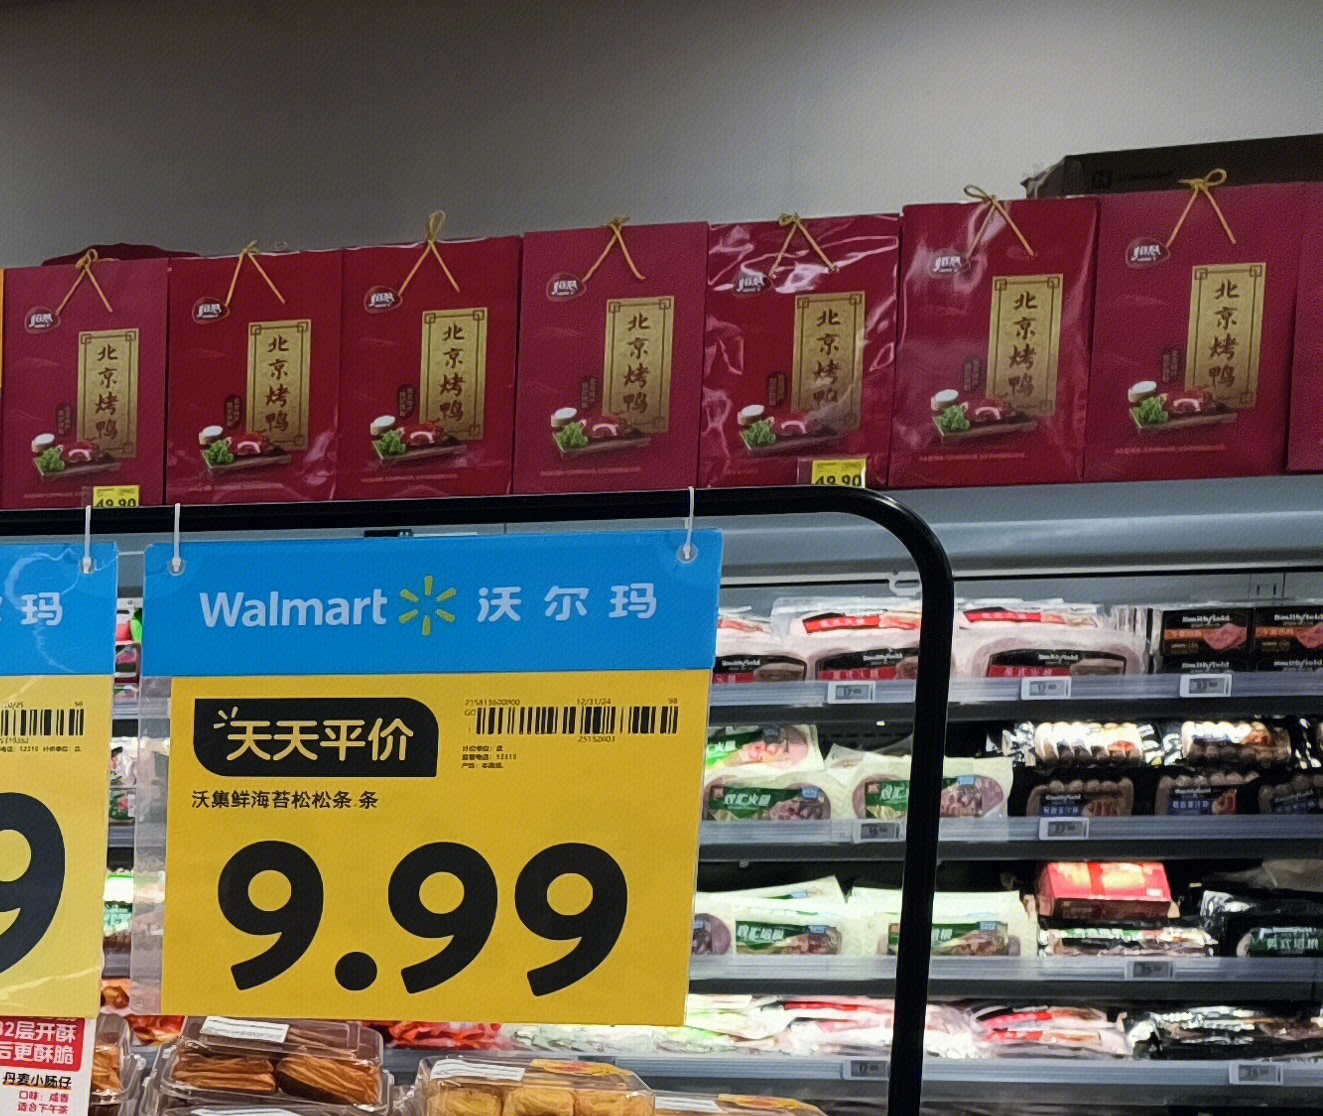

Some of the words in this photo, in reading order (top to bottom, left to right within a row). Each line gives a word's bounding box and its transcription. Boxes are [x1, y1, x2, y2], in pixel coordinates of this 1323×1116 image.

[264, 335, 290, 432] 北京烤鸭
[439, 324, 466, 422] 北京烤鸭
[622, 312, 651, 414] 北京烤鸭
[1007, 291, 1038, 397] 北京烤鸭
[1208, 280, 1240, 390] 北京烤鸭
[95, 343, 119, 441] 北京烤鸭
[95, 498, 136, 507] 4990
[815, 474, 861, 484] 4990
[200, 589, 387, 627] Walmart
[477, 583, 657, 622] 沃尔玛
[226, 718, 414, 761] 天天平价
[218, 840, 628, 996] 9.99
[3, 1071, 72, 1089] 丹麦小肠仔
